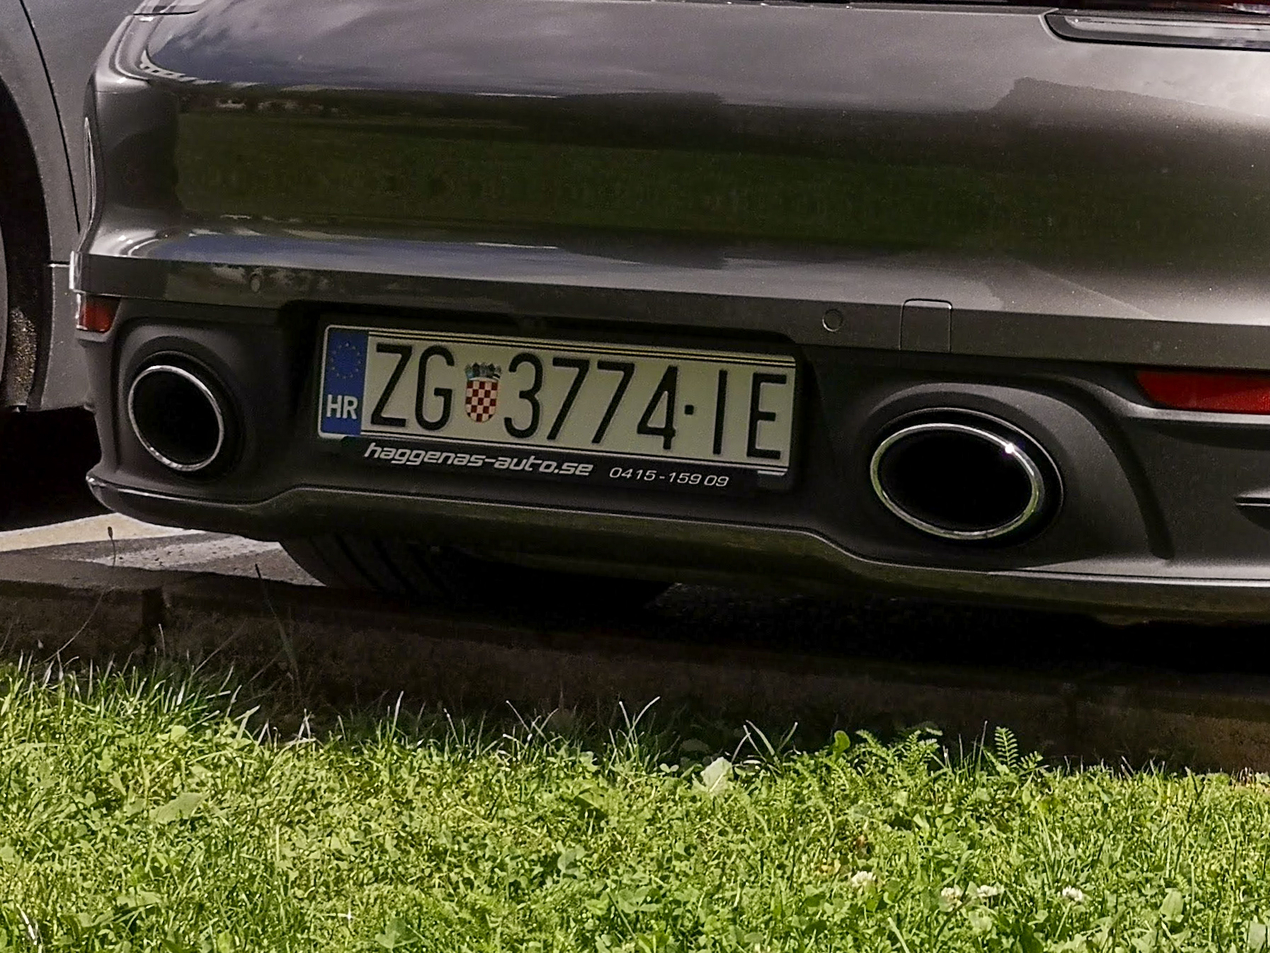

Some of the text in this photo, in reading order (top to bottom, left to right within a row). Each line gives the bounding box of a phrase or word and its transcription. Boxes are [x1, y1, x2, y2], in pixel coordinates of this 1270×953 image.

[371, 344, 454, 431] ZG
[326, 395, 358, 420] HR
[364, 442, 594, 477] haggenas-auto.se
[609, 467, 702, 485] 0415-159
